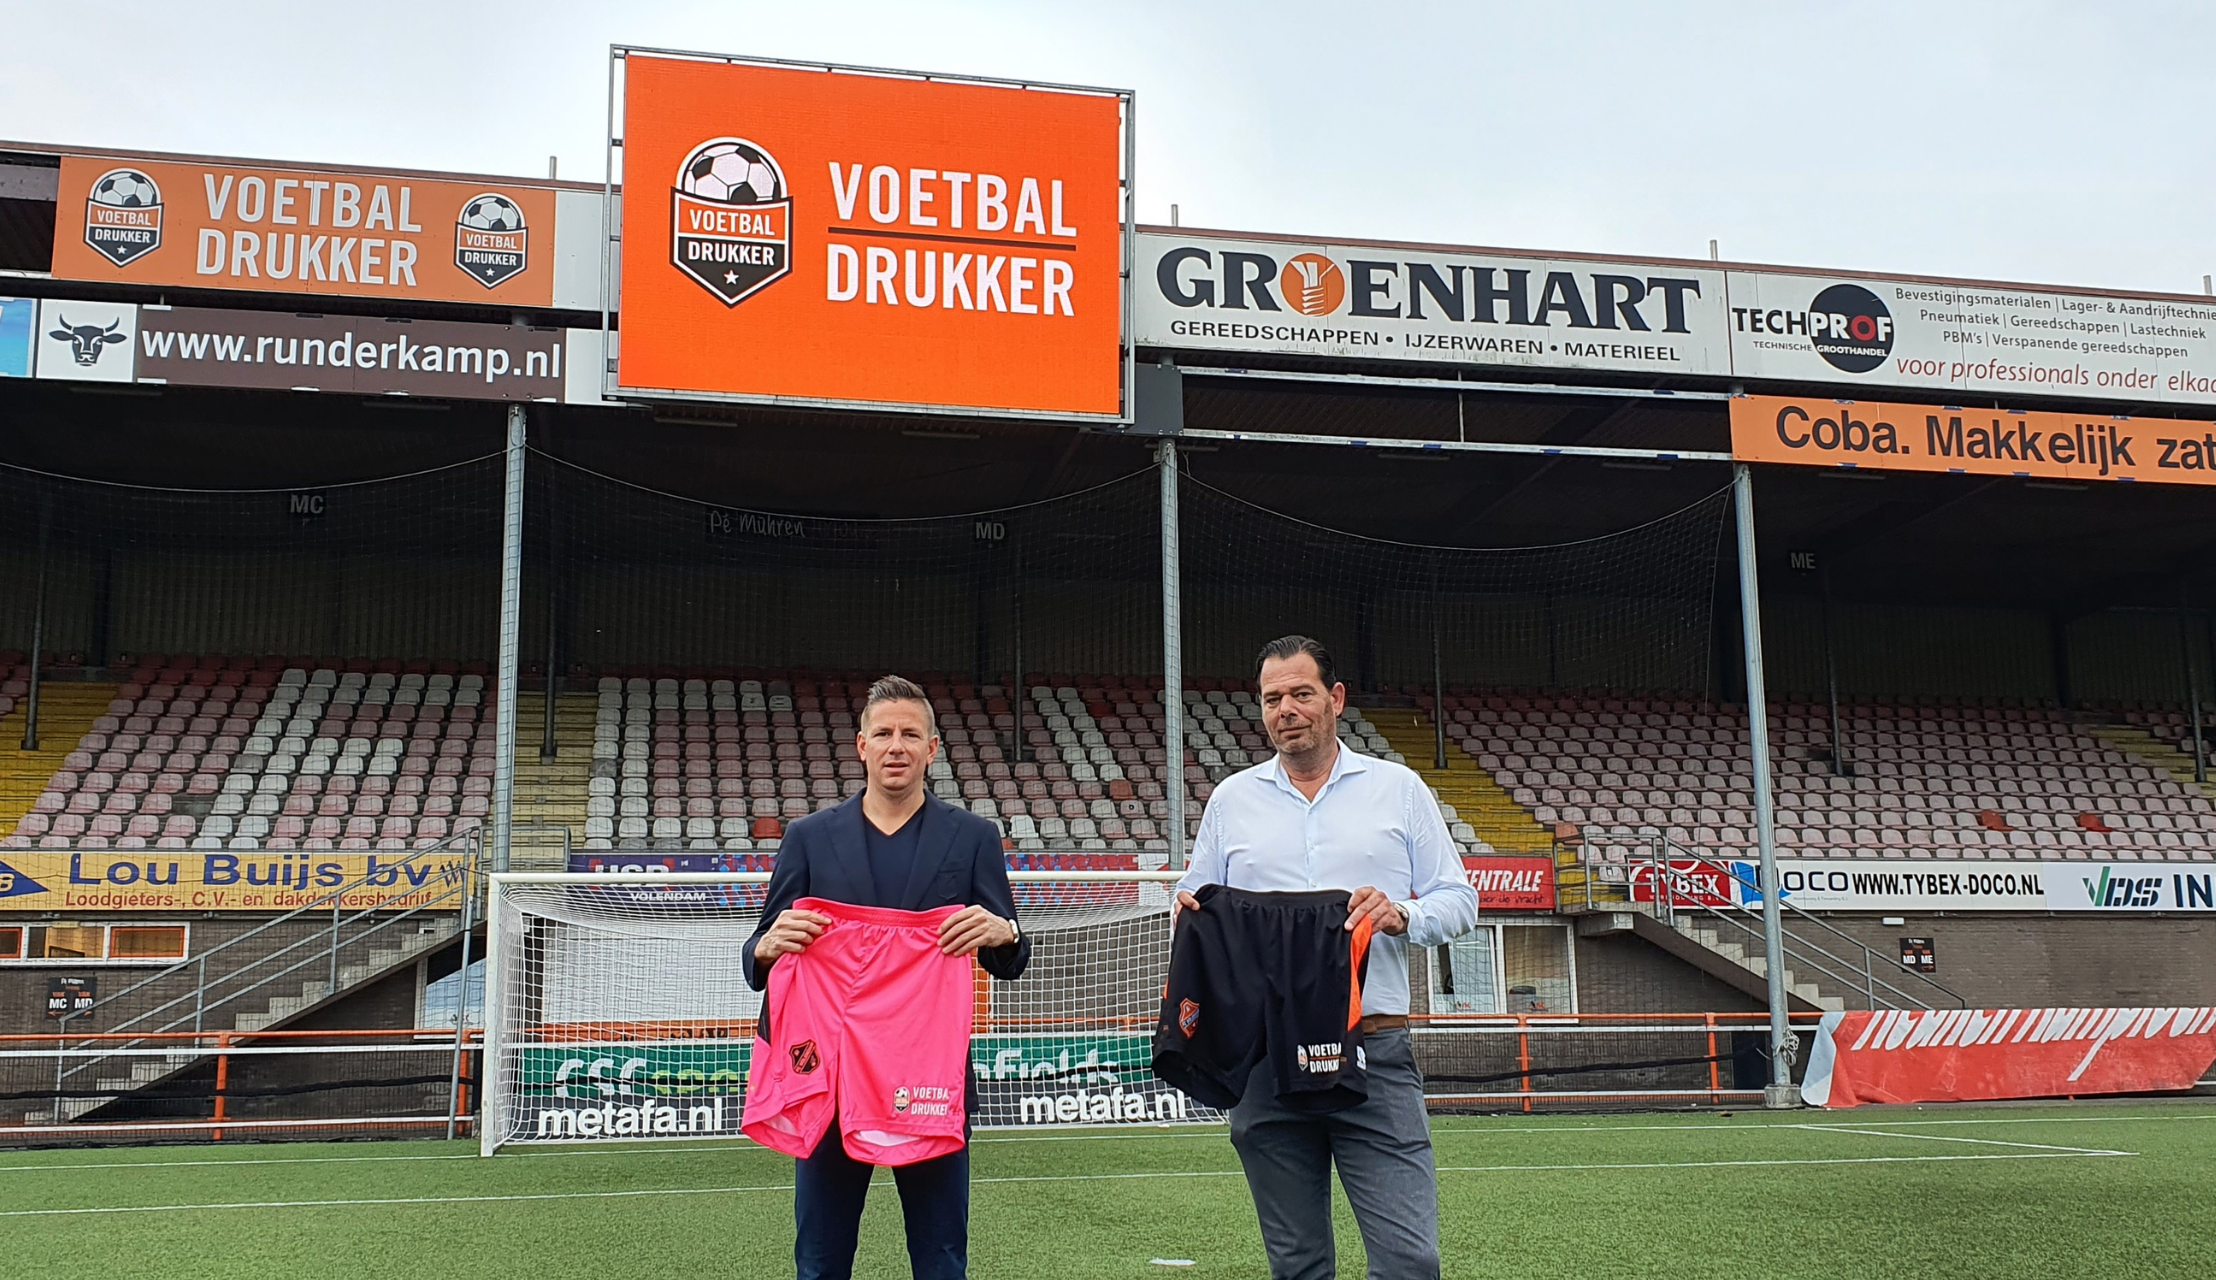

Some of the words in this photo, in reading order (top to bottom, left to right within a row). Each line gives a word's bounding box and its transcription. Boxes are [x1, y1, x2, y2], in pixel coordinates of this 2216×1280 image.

[202, 173, 422, 233] VOETBAL
[828, 161, 1077, 237] VOETBAL
[97, 209, 152, 226] VOETBAL
[688, 208, 776, 236] VOETBAL
[94, 228, 151, 244] DRUKKER
[465, 233, 518, 249] VOETBAL
[196, 228, 418, 287] DRUKKER
[464, 251, 517, 267] DRUKKER
[687, 241, 775, 267] DRUKKER
[826, 243, 1075, 317] DRUKKER
[1896, 287, 2051, 309] Bevestigingsmaterialen
[2062, 298, 2103, 314] Lager-
[2106, 301, 2116, 313] &
[1731, 307, 1892, 342] TECHPROF
[1920, 309, 2000, 325] Pneumatiek
[2011, 315, 2120, 335] Gereedschappen
[2130, 322, 2207, 339] Lastechniek
[1170, 319, 1379, 346] GEREEDSCHAPPEN
[1404, 333, 1544, 355] IJZERWAREN
[1564, 342, 1681, 362] MATERIEEL
[1753, 340, 1813, 352] TECHNISCHE
[1816, 344, 1888, 357] GROOTHANDEL
[1992, 333, 2078, 350] Verspanende
[2081, 341, 2188, 359] gereedschappen
[142, 328, 562, 384] www.runderkamp.nl
[1896, 358, 1946, 377] voor
[1950, 358, 2089, 386] professionals
[2097, 367, 2158, 389] onder
[1775, 405, 1911, 455] Coba.
[1925, 415, 2137, 477] Makkelijk
[290, 493, 325, 515] MC
[975, 521, 1006, 541] MD
[1790, 552, 1816, 570] ME
[69, 853, 179, 886] Lou
[203, 854, 344, 891] Buijs
[366, 855, 432, 887] bv
[1852, 873, 2045, 896] WWW.TYBEX-DOCO.NL
[243, 894, 263, 907] en
[629, 892, 707, 902] VOLENDAM
[49, 998, 67, 1009] MC
[537, 1097, 723, 1137] metafa.nl
[1019, 1086, 1187, 1123] metafa.nl
